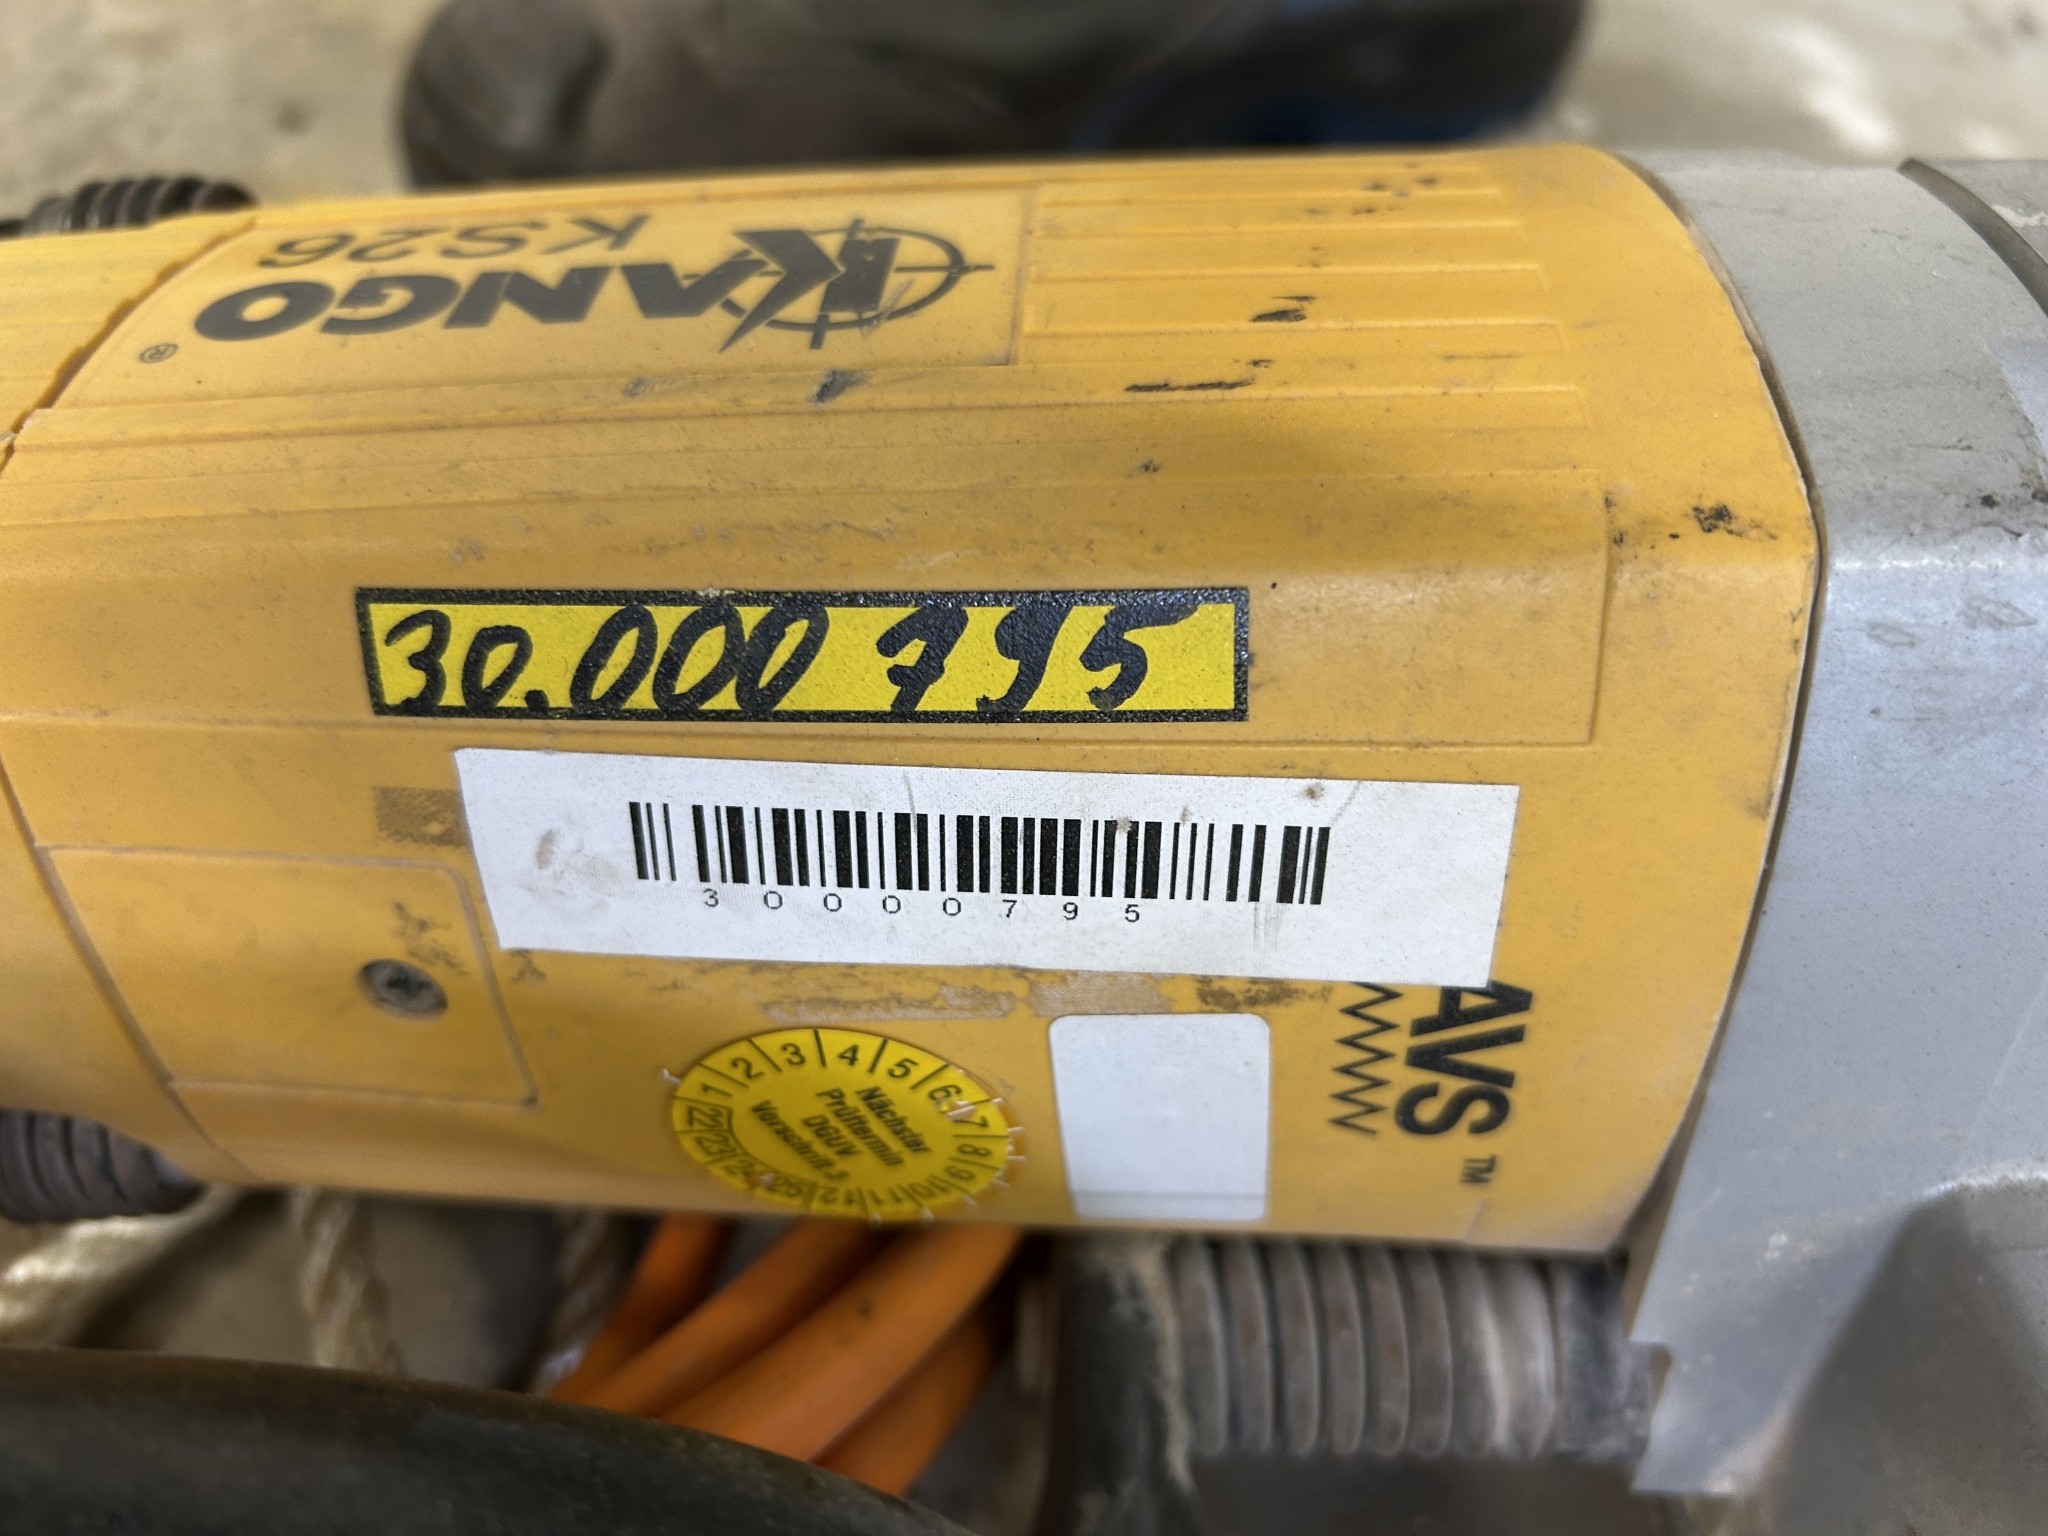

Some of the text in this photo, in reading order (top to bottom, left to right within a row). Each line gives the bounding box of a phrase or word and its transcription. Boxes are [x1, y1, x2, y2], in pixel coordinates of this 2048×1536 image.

[194, 230, 898, 352] KANGO
[258, 214, 650, 268] KS26
[731, 1057, 764, 1080] 2
[780, 1043, 806, 1066] 3
[837, 1043, 860, 1067] 4
[887, 1057, 919, 1080] 5
[956, 1143, 993, 1159] 8
[1394, 980, 1533, 1136] AVS
[854, 1086, 932, 1154] Nächster
